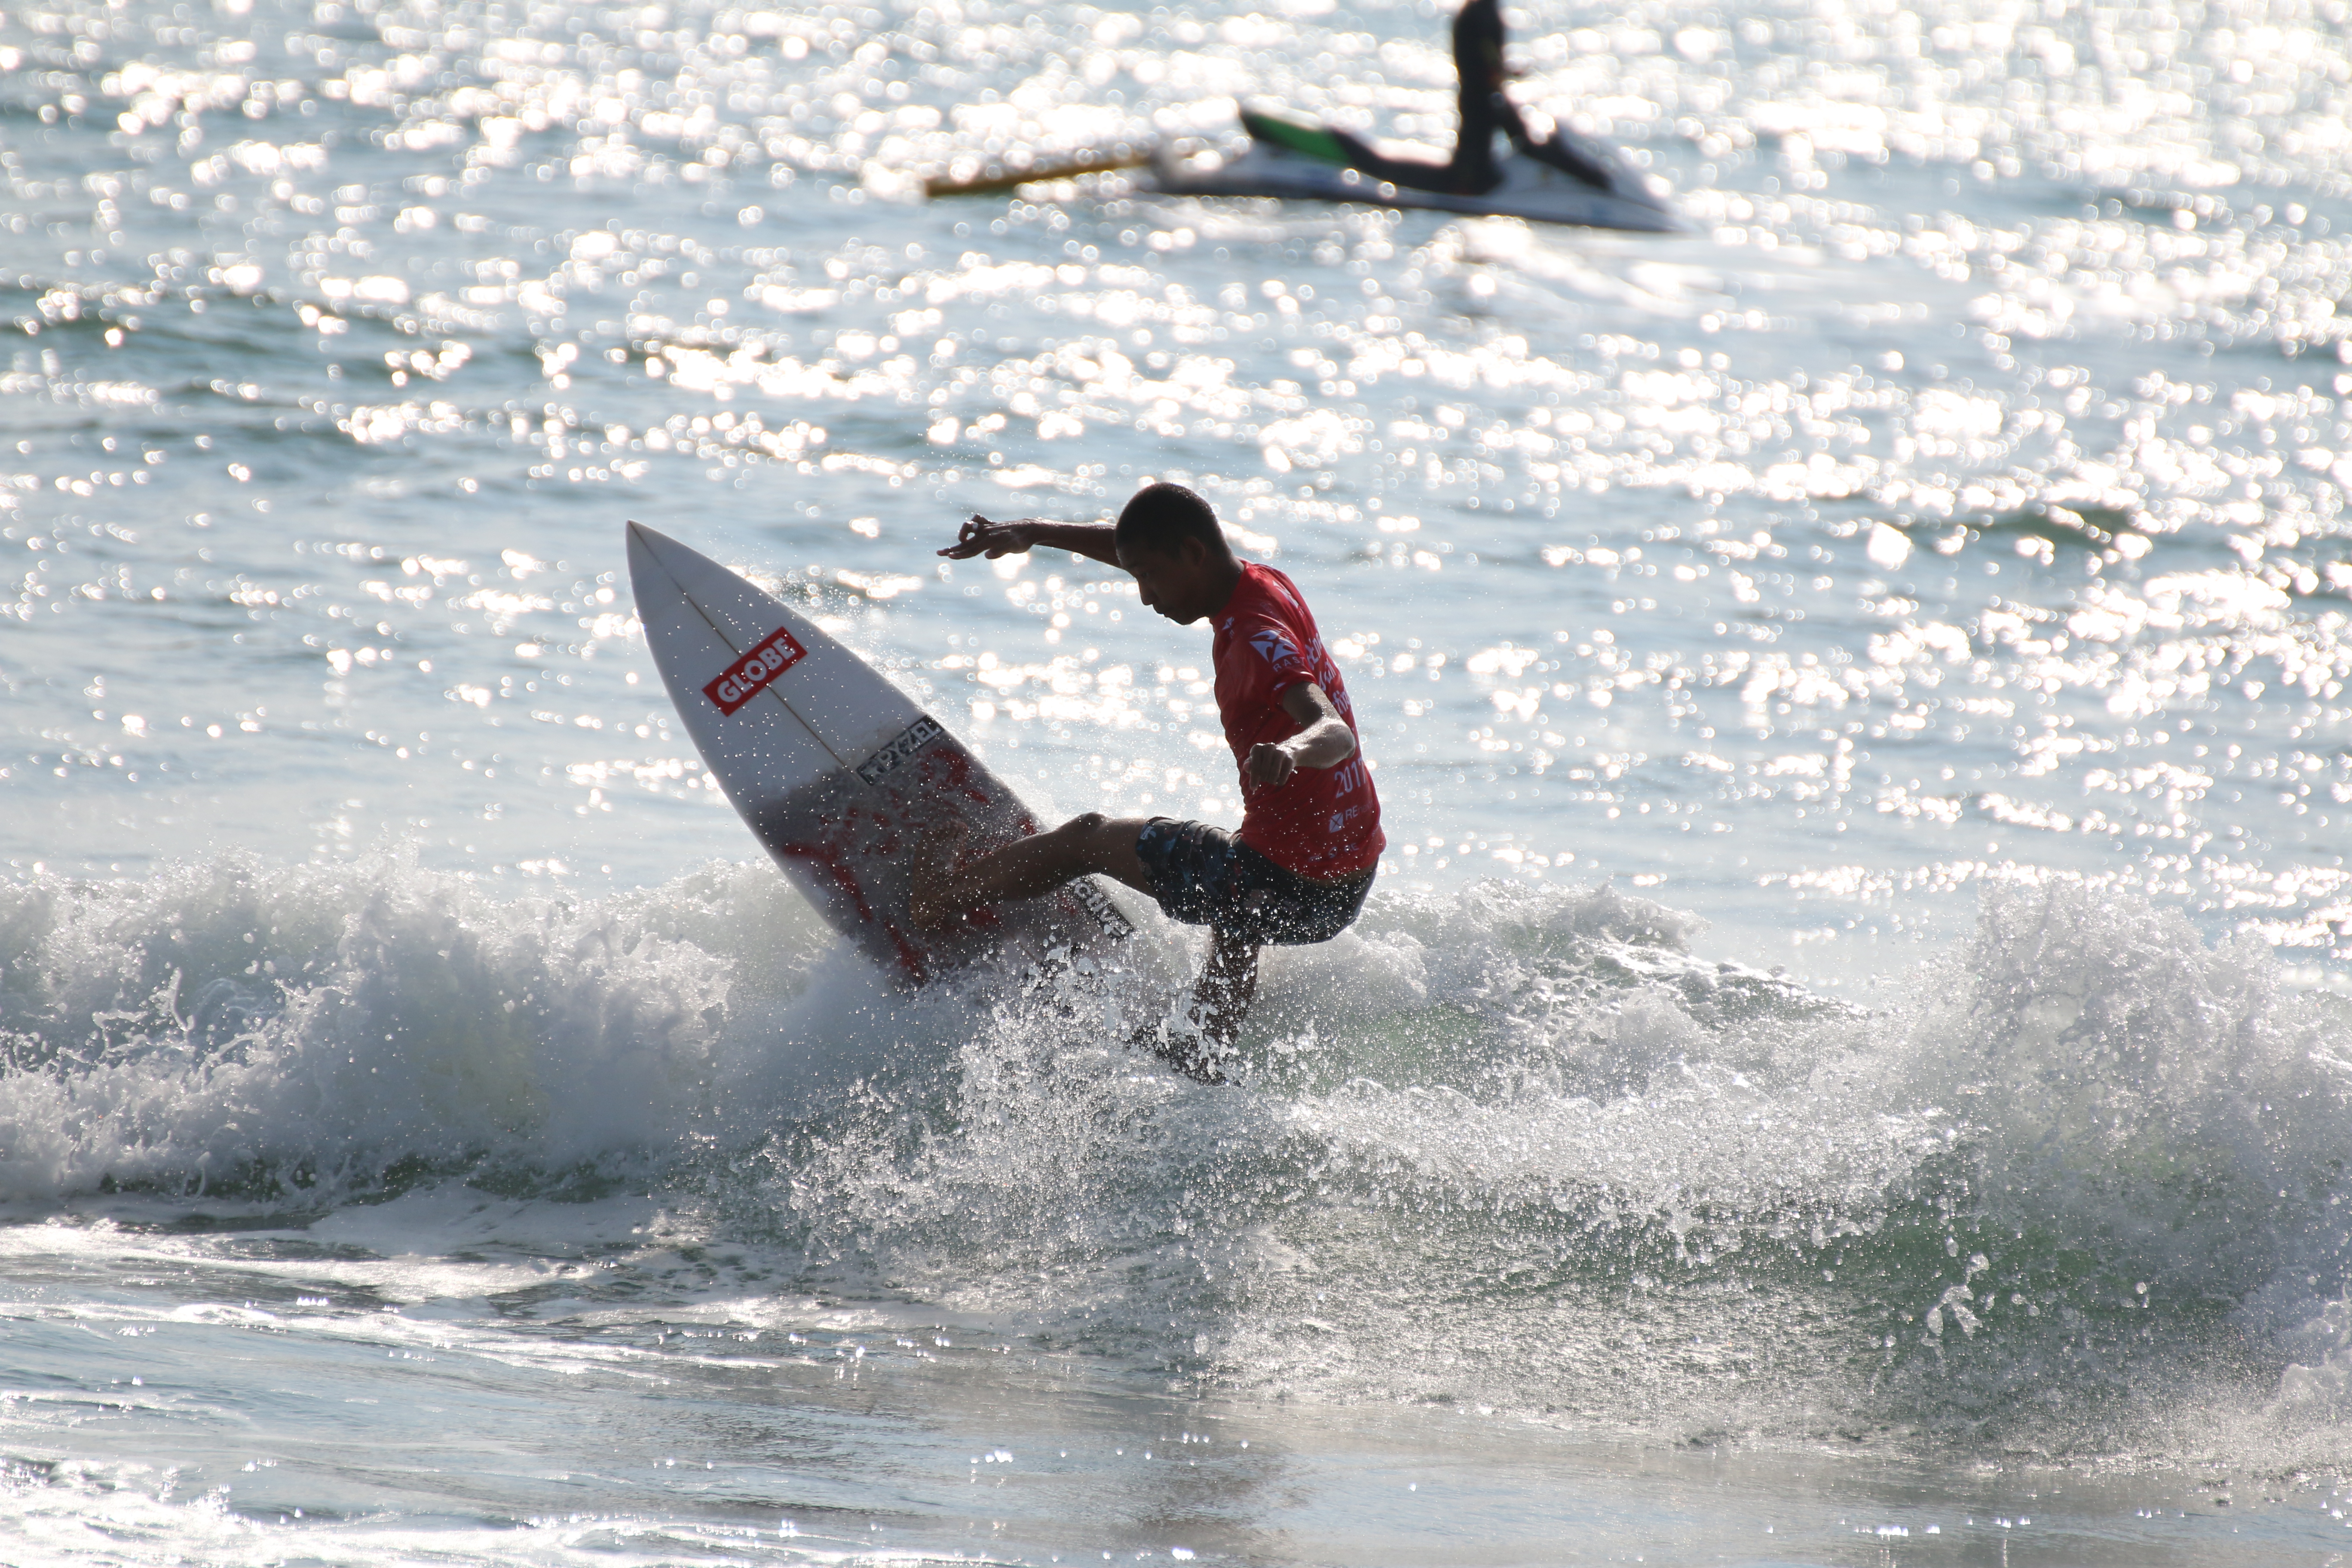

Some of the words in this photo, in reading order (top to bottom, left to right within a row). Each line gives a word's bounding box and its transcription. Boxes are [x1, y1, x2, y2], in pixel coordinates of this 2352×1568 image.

[717, 637, 796, 703] GLOBE
[875, 720, 942, 771] PYZEL
[1334, 758, 1366, 799] 2017
